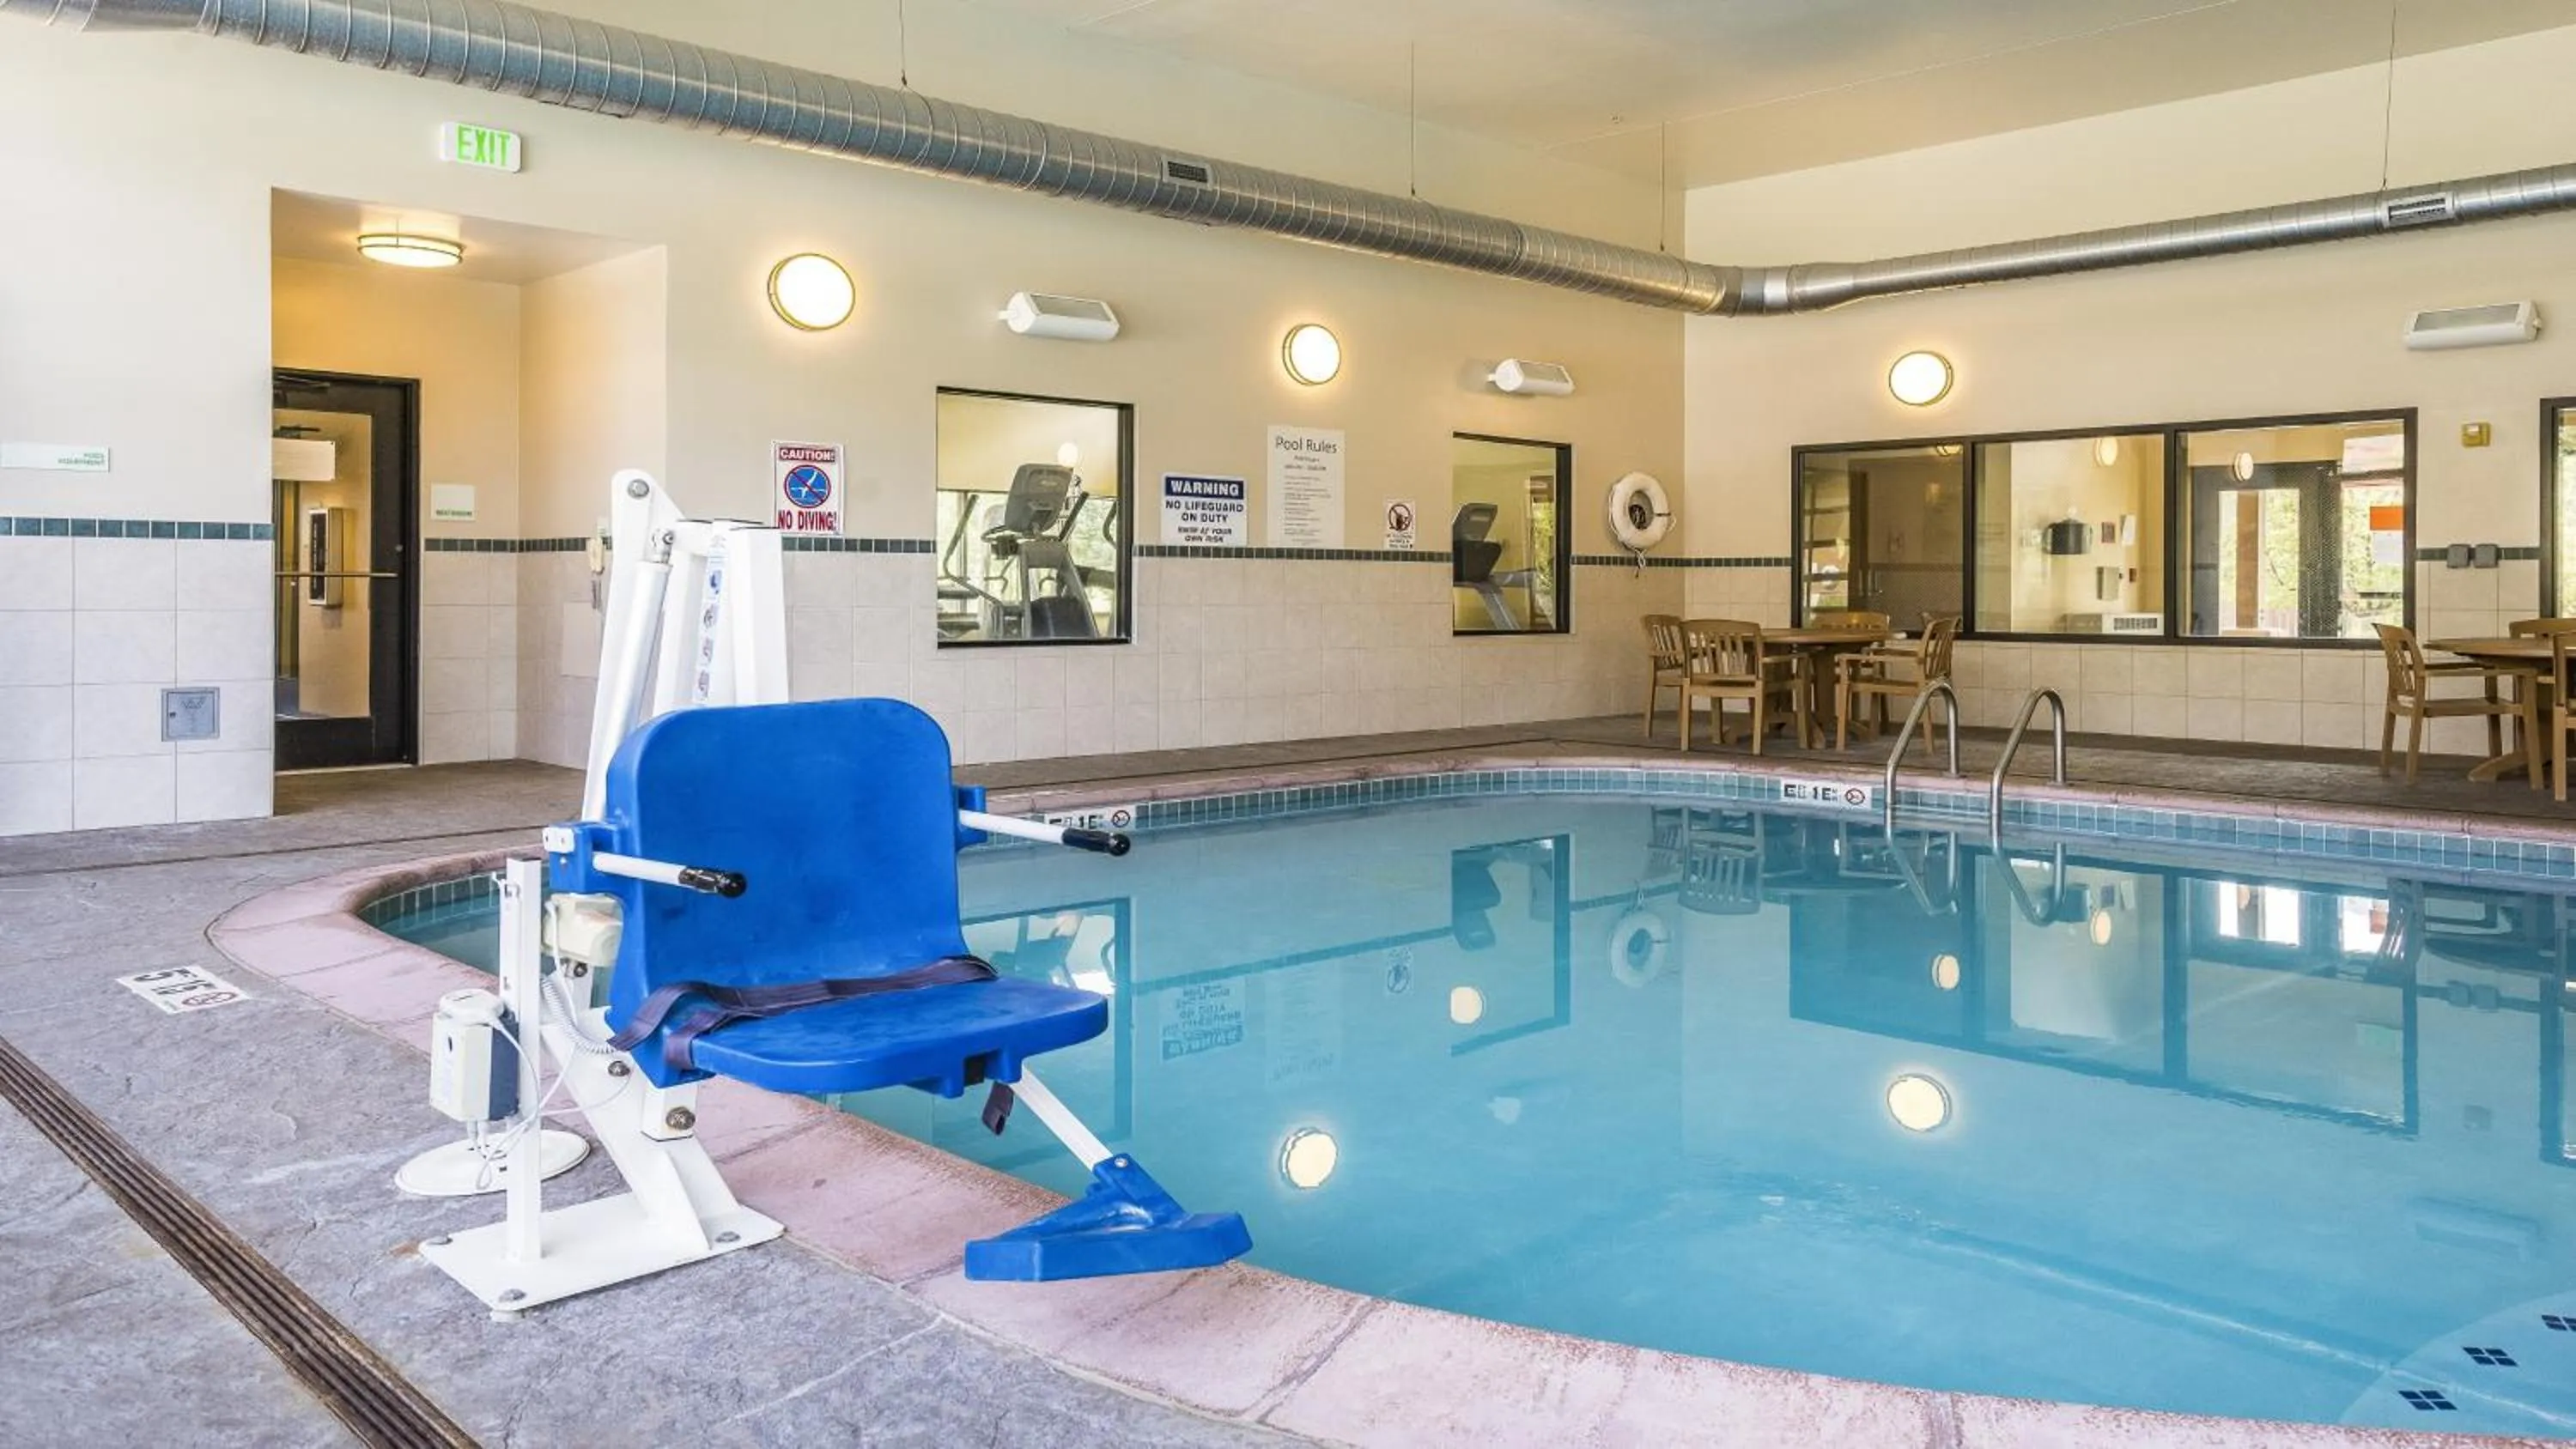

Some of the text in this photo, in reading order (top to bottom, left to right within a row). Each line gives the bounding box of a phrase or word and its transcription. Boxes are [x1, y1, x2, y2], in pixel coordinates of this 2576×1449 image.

[458, 124, 511, 167] EXIT
[1275, 436, 1338, 454] Pool Rules
[780, 449, 835, 461] CAUTION!
[1170, 480, 1240, 497] WARNING
[1165, 500, 1244, 512] NO LIFEGUARD
[778, 510, 837, 530] NO DIVING!
[1181, 512, 1229, 523] ON DUTY
